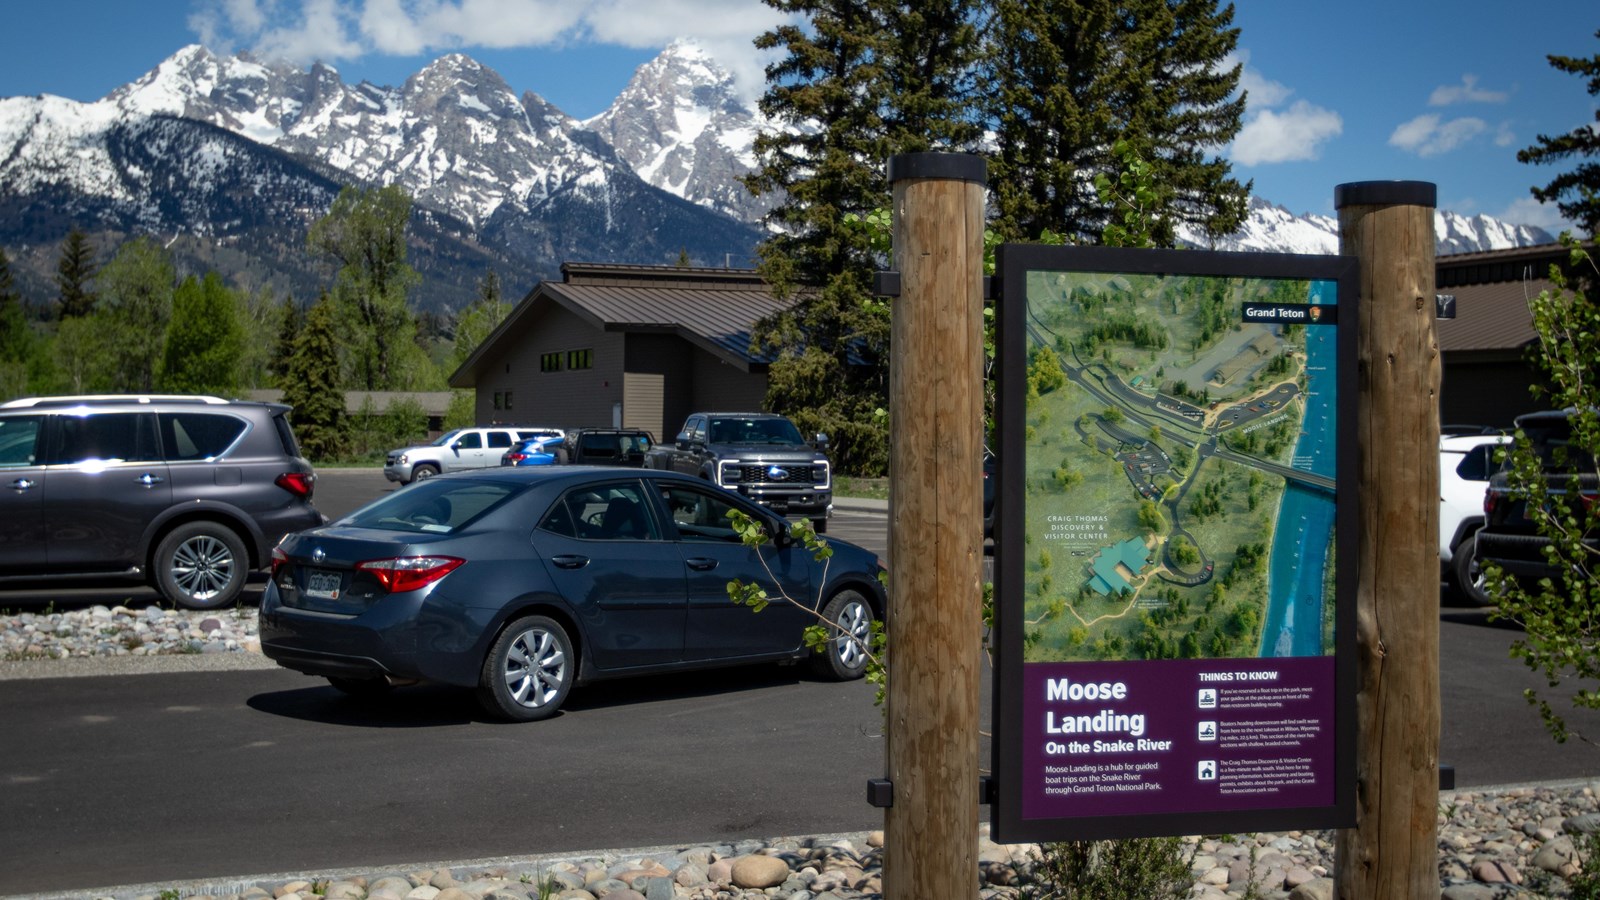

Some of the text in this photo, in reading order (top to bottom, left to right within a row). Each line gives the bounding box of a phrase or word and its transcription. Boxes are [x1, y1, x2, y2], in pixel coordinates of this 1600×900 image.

[1247, 308, 1304, 318] Grand Teton
[1242, 413, 1288, 434] MOOSE LANDING
[1199, 672, 1278, 681] THINGS TO KNOW
[1046, 678, 1126, 702] Moose
[1046, 710, 1145, 736] Landing
[1046, 738, 1171, 754] On the Snake River
[1070, 764, 1096, 773] Landing
[1136, 762, 1158, 771] guided
[1063, 776, 1077, 784] trips
[1046, 786, 1072, 795] through
